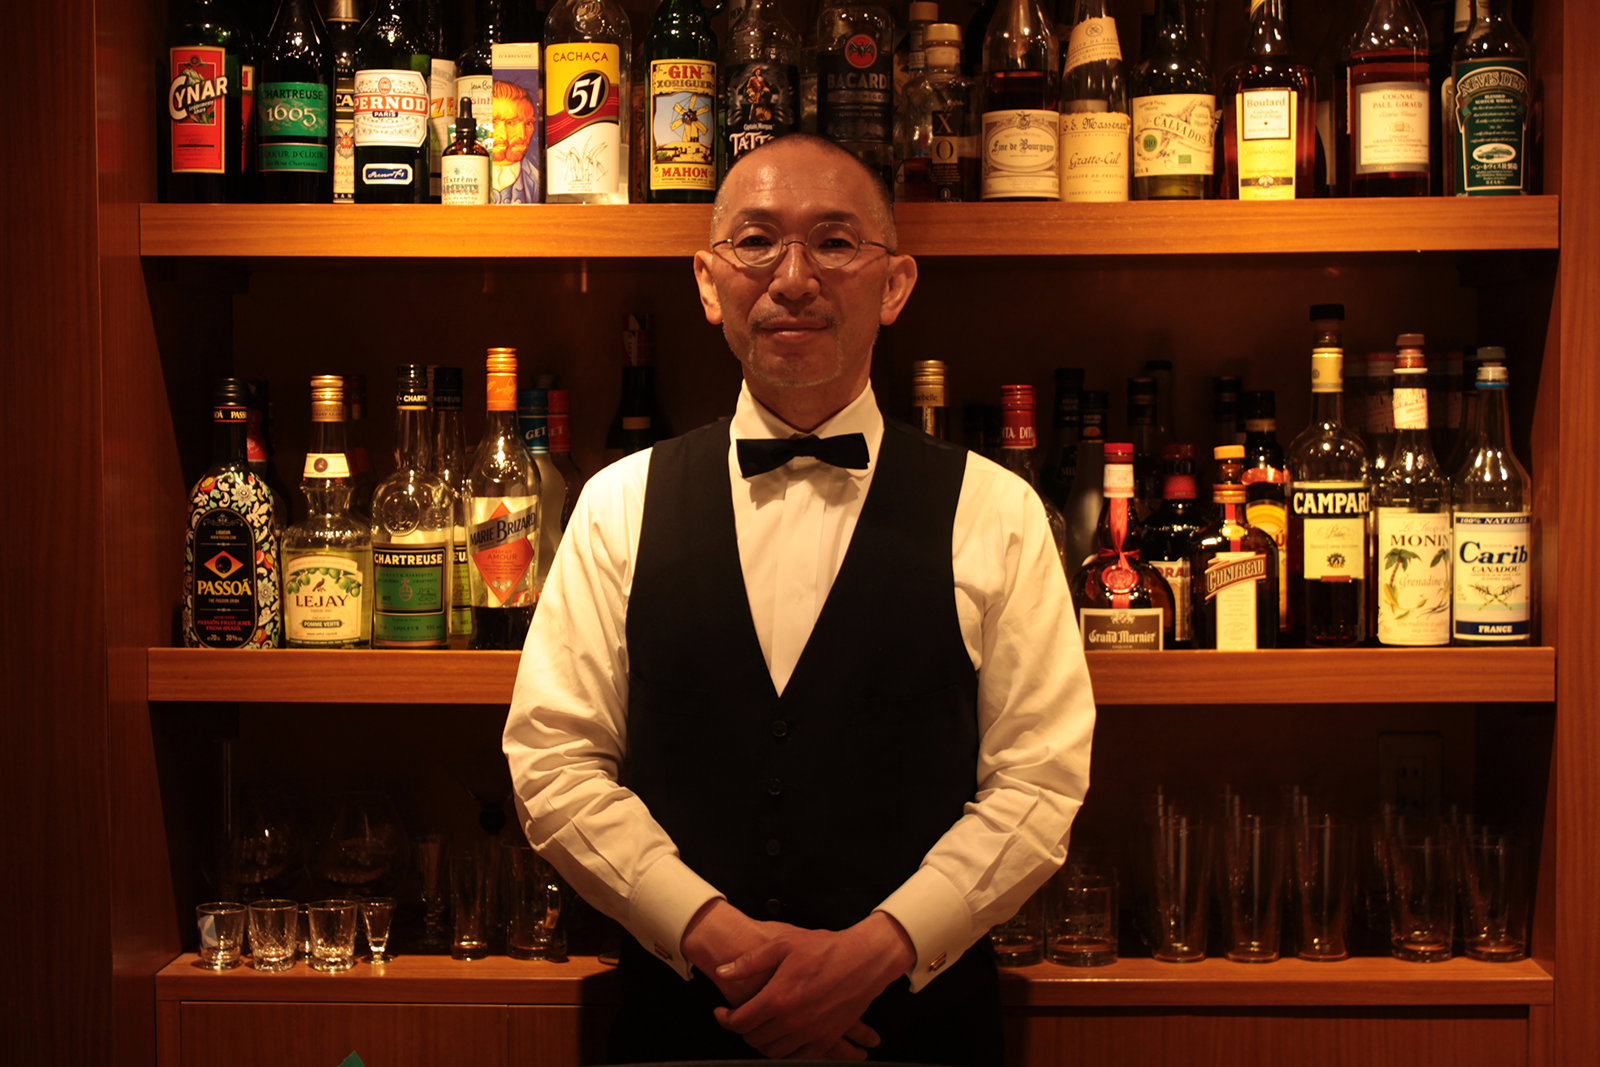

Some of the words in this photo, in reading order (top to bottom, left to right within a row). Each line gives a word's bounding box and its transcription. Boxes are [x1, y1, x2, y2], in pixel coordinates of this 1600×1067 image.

[553, 52, 609, 63] CACHAÇA
[668, 65, 702, 79] GIN
[656, 79, 713, 89] XORIGUER
[1461, 72, 1500, 97] NEVIS
[169, 75, 228, 120] CYNAR
[261, 89, 323, 100] CHARTREUSE
[567, 76, 602, 114] 51
[354, 96, 427, 111] PERNOD
[1246, 98, 1286, 107] Boulard
[267, 104, 316, 127] 1605
[1154, 116, 1207, 145] CALVADOS
[340, 137, 352, 145] 45
[661, 167, 708, 178] MAHON
[525, 426, 546, 440] GET
[1293, 492, 1370, 514] CAMPARI
[470, 527, 494, 546] MARIE
[496, 512, 536, 543] BRIZARD
[1390, 534, 1449, 547] MONIN
[374, 553, 443, 565] CHARTREUSE
[1459, 541, 1529, 564] Carib
[1207, 558, 1264, 593] COINTREAU
[1471, 565, 1521, 573] CANADOU
[1398, 573, 1443, 590] Grenadine
[295, 595, 348, 607] LEJAY
[1089, 629, 1117, 643] Grand
[1118, 630, 1157, 643] Marnier
[1478, 625, 1513, 633] FRANCE
